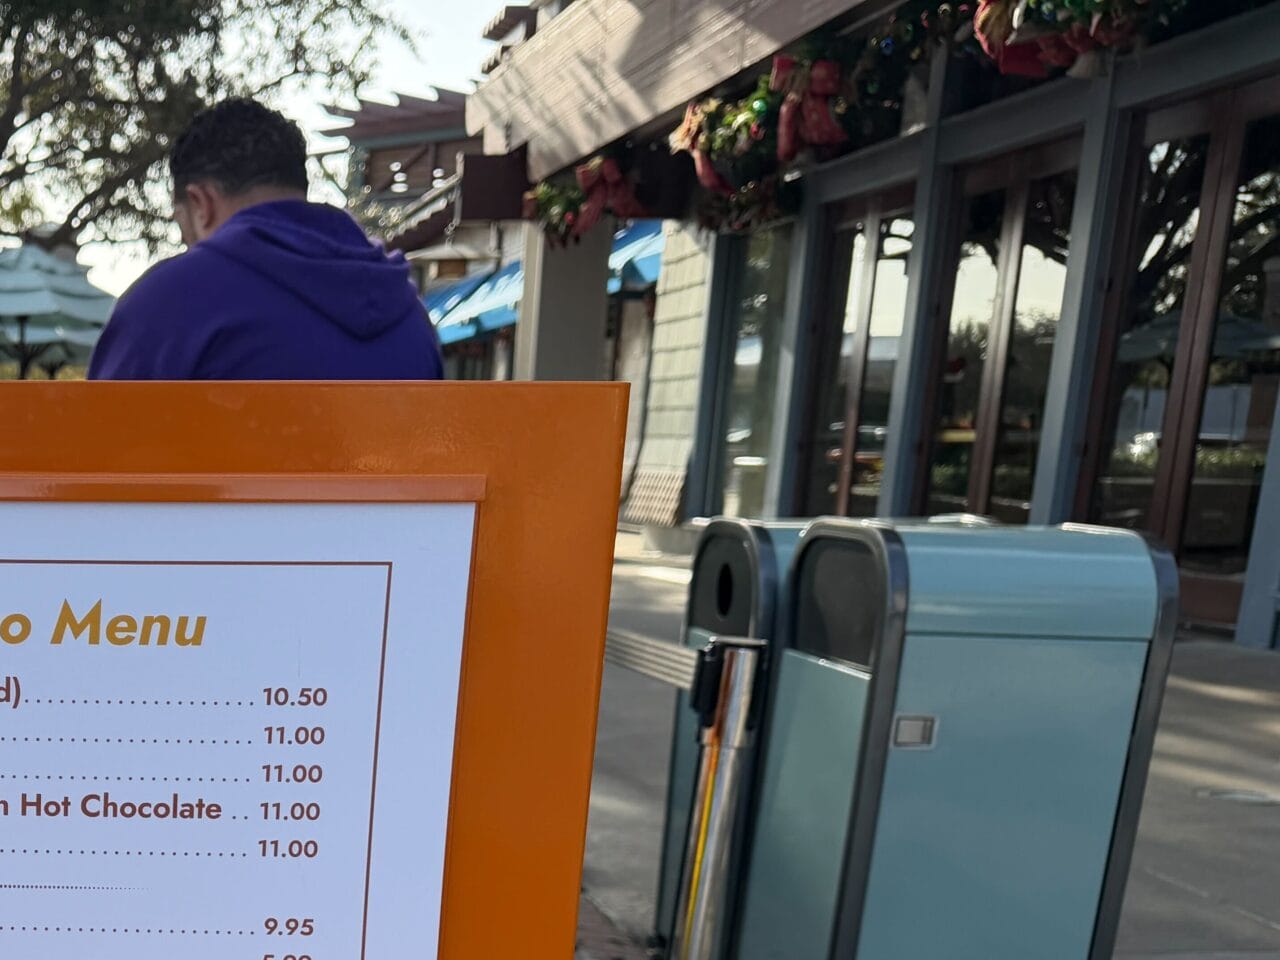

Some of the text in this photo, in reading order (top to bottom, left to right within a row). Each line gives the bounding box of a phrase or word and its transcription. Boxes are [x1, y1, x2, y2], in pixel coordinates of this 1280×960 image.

[49, 599, 207, 646] Menu
[262, 688, 327, 706] 10.50
[264, 727, 325, 745] 11.00
[261, 765, 322, 783] 11.00
[20, 793, 71, 816] Hot
[80, 792, 221, 819] Chocolate
[260, 803, 320, 820] 11.00
[258, 840, 318, 858] 11.00
[264, 918, 313, 936] 9.95
